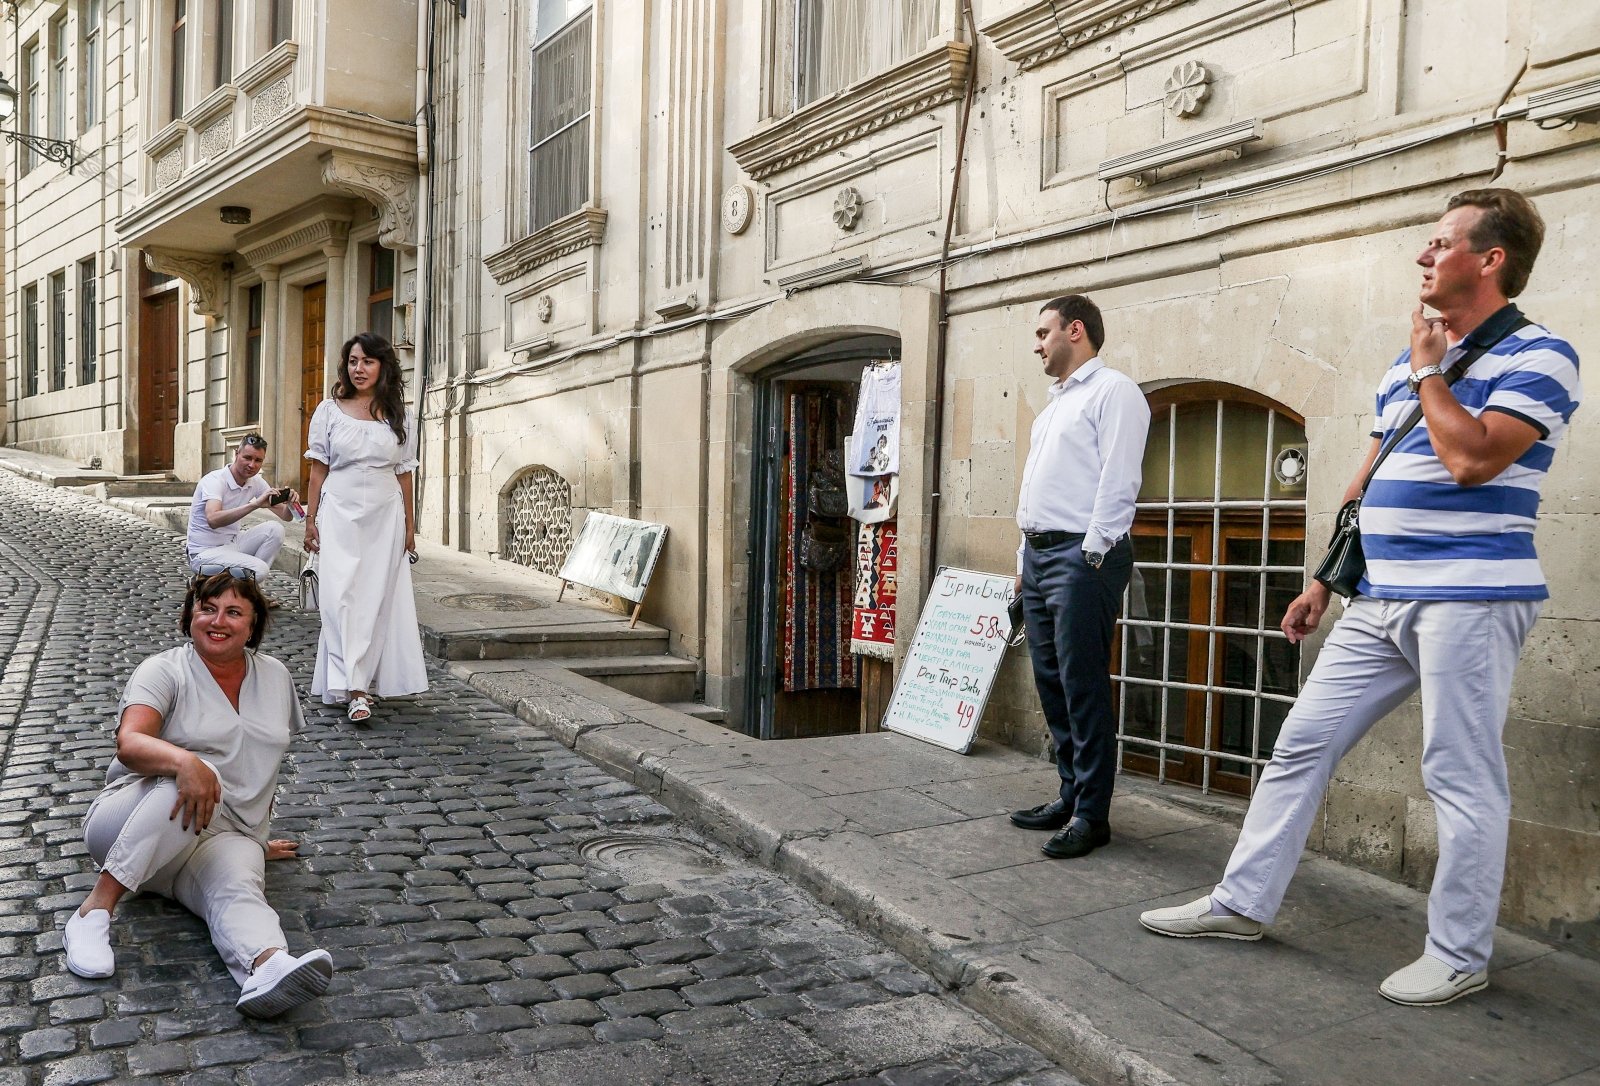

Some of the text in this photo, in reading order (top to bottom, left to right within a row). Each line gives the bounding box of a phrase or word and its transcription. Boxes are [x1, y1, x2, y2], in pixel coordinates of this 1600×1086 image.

[731, 200, 738, 217] 8
[917, 665, 937, 684] Day
[957, 700, 974, 728] 49
